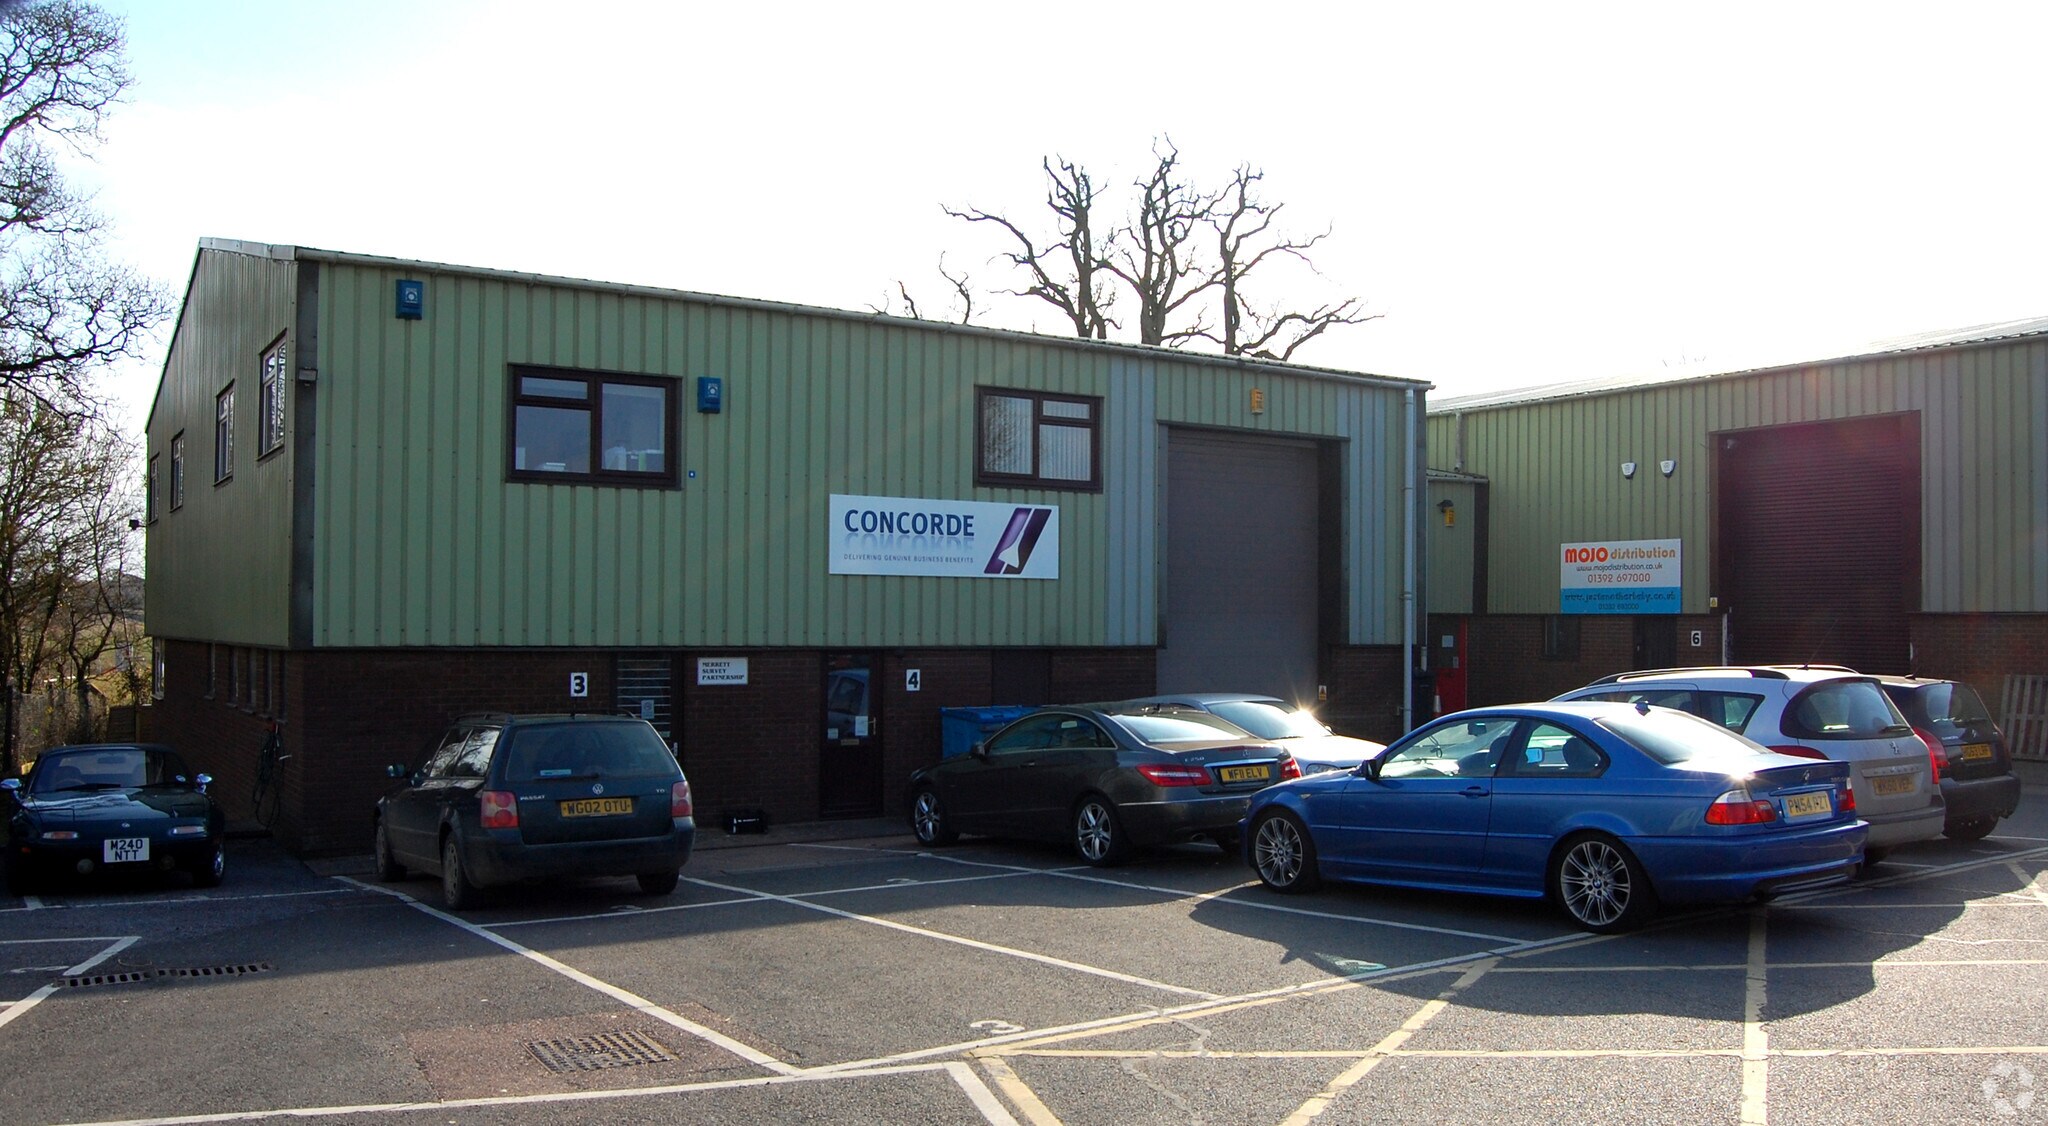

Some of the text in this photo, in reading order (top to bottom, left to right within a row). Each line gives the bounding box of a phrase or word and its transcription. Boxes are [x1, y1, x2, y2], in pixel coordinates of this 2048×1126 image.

[844, 509, 975, 537] CONCORDE
[843, 553, 974, 564] DELIVERING GENUINE BUSINESS BENEFITS
[1610, 546, 1676, 560] distribution
[1576, 562, 1663, 573] www.mojodistribution.co.uk
[1587, 572, 1651, 584] 01392 697000
[1692, 632, 1700, 645] 6
[573, 675, 586, 694] 3
[908, 671, 919, 689] 4
[566, 801, 601, 815] WG02
[111, 839, 143, 850] M240
[115, 850, 138, 861] NTT
